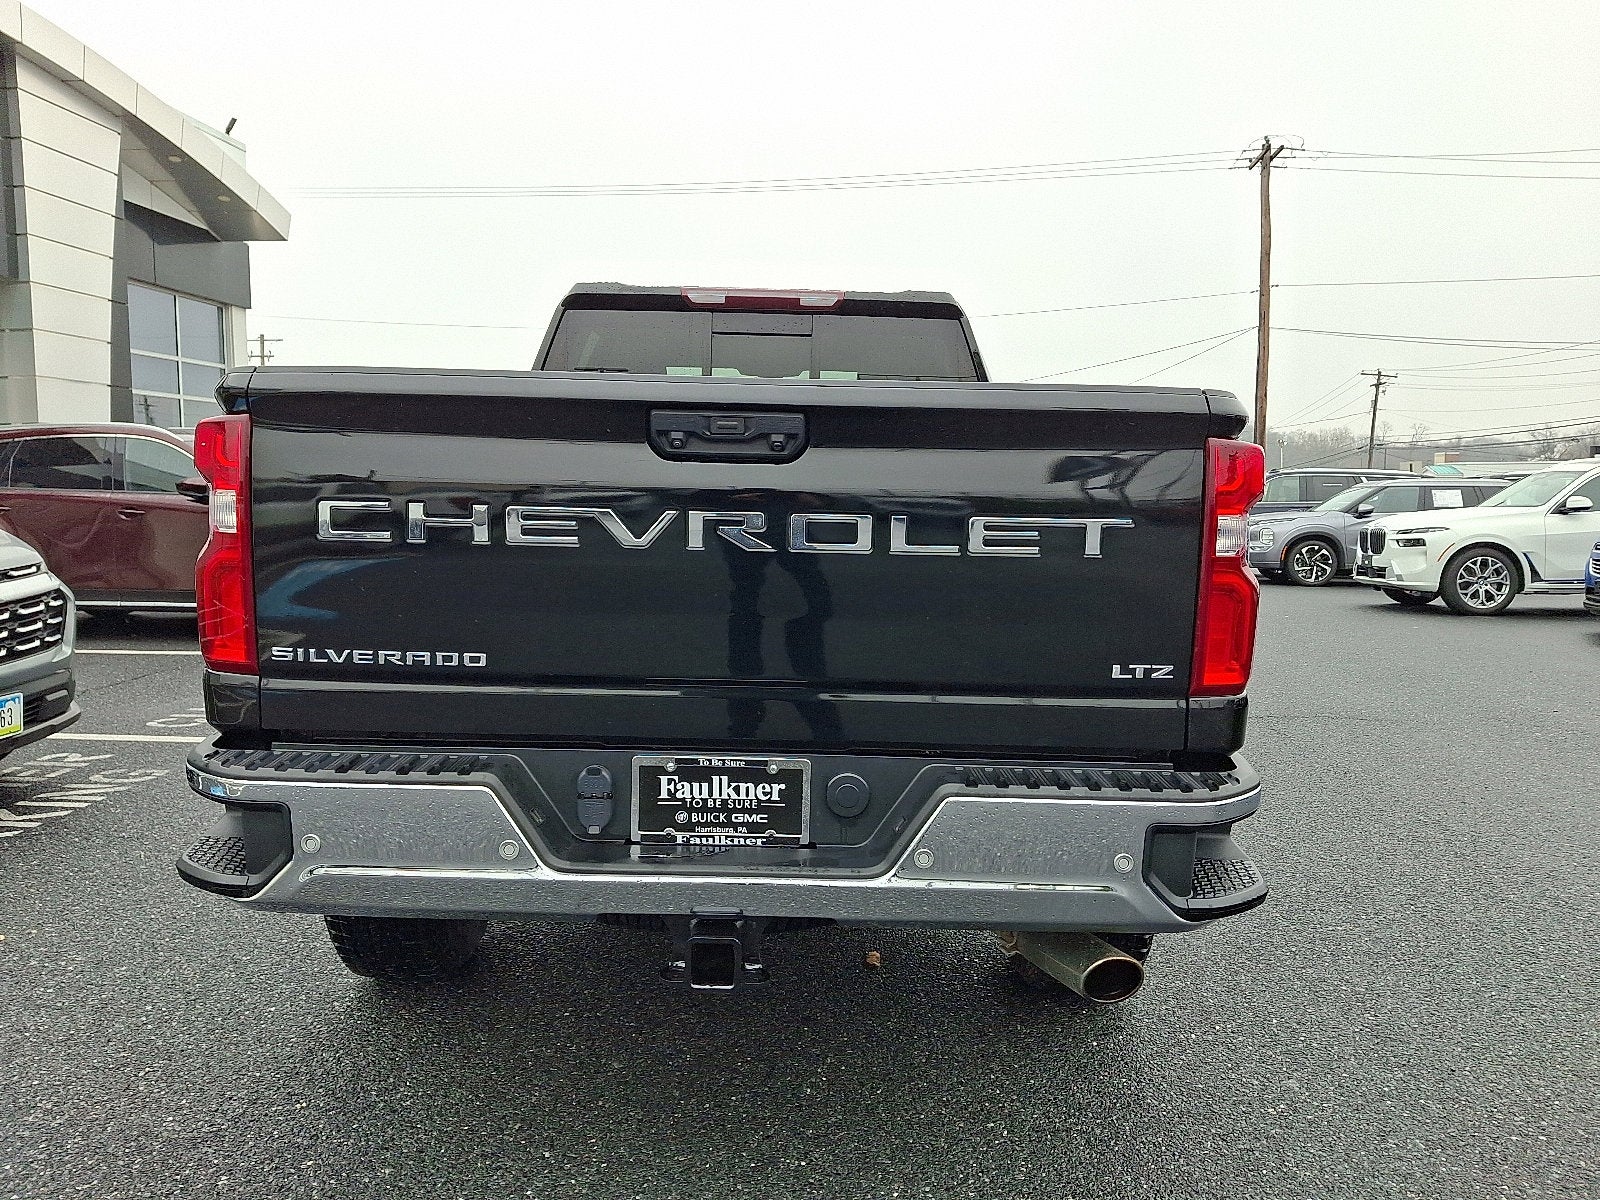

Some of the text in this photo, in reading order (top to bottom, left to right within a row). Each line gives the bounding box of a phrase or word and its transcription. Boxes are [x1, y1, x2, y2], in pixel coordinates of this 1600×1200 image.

[316, 499, 1135, 559] CHEVROLET
[270, 645, 488, 669] SILVERADO
[1110, 663, 1175, 680] LTZ
[697, 758, 746, 767] To Be Sure
[656, 775, 786, 801] Faulkner
[685, 799, 758, 809] TO BE SURE
[691, 812, 769, 823] BUICK GMC
[737, 826, 748, 834] PA
[674, 834, 768, 846] Faulkner
